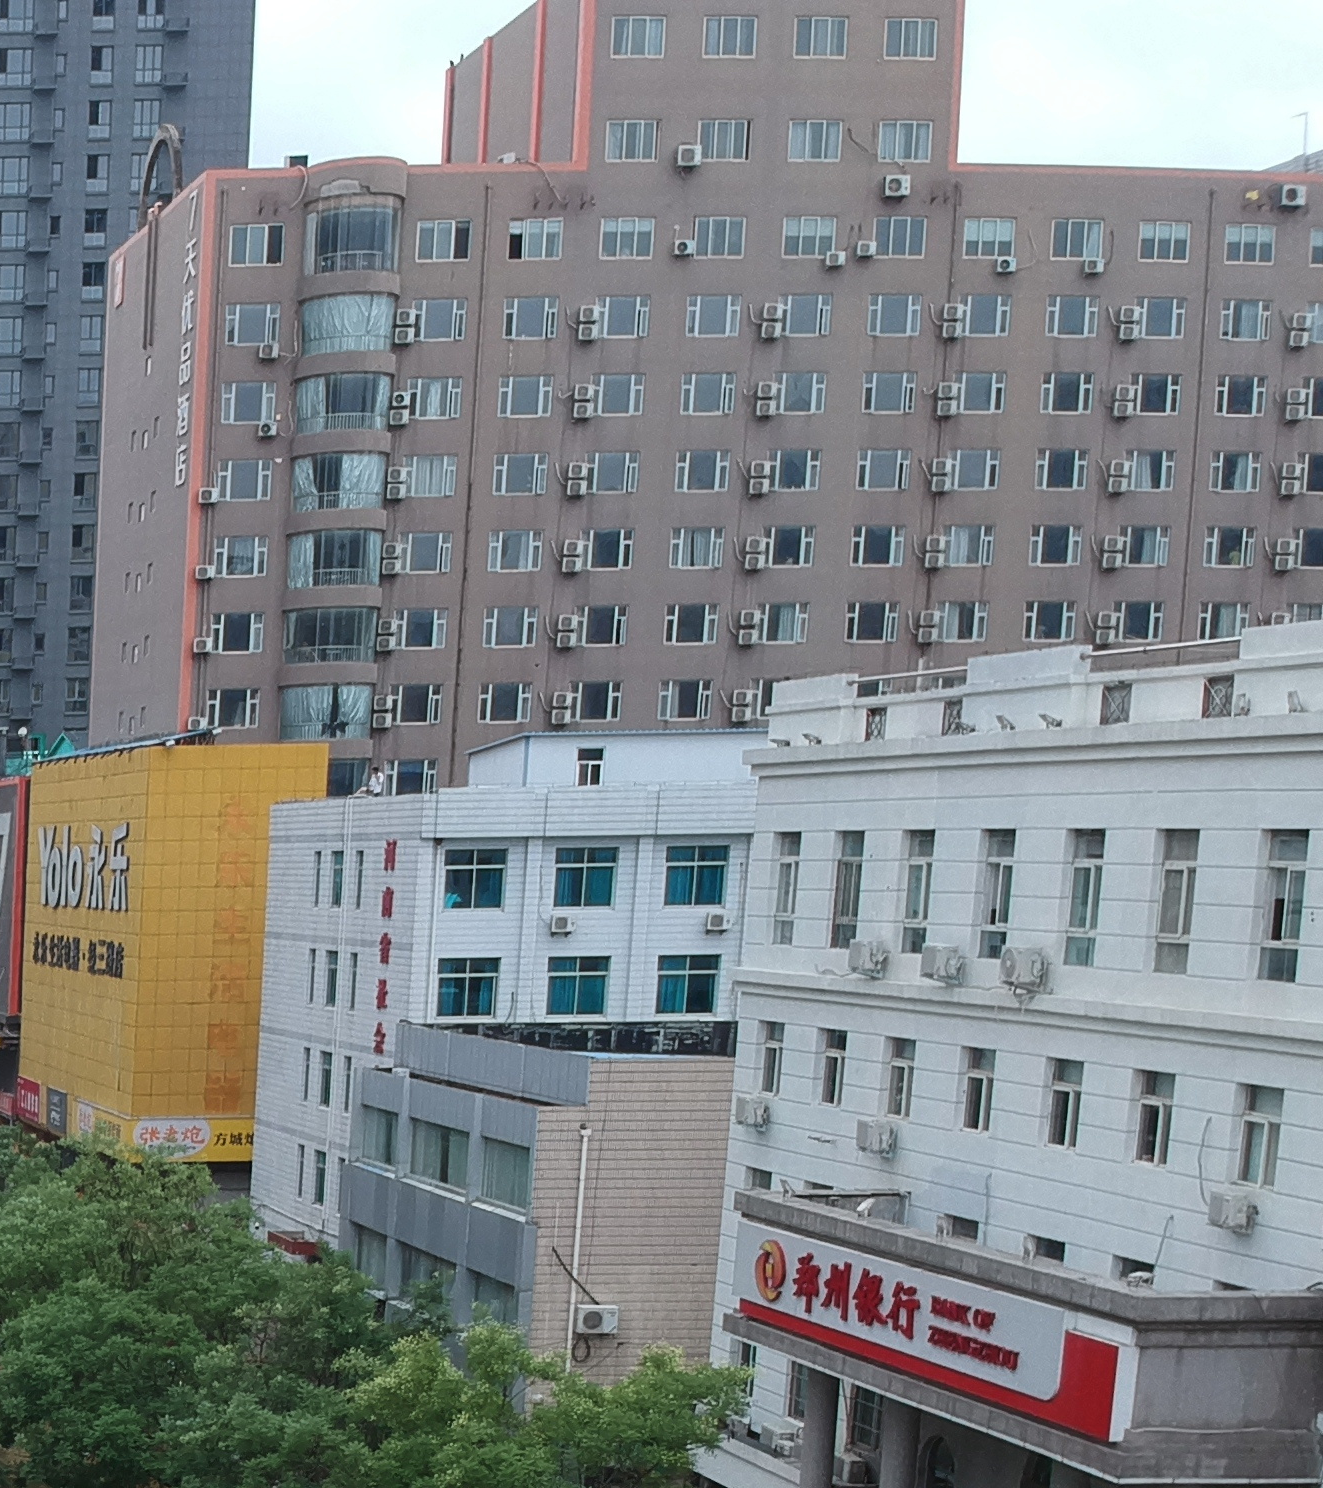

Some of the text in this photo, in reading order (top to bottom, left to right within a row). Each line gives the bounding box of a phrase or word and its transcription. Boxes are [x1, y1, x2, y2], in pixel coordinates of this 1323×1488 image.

[174, 189, 199, 488] 7天优品酒店
[38, 825, 84, 909] Yolo
[85, 822, 130, 912] 永乐
[792, 1251, 922, 1341] 郑州银行
